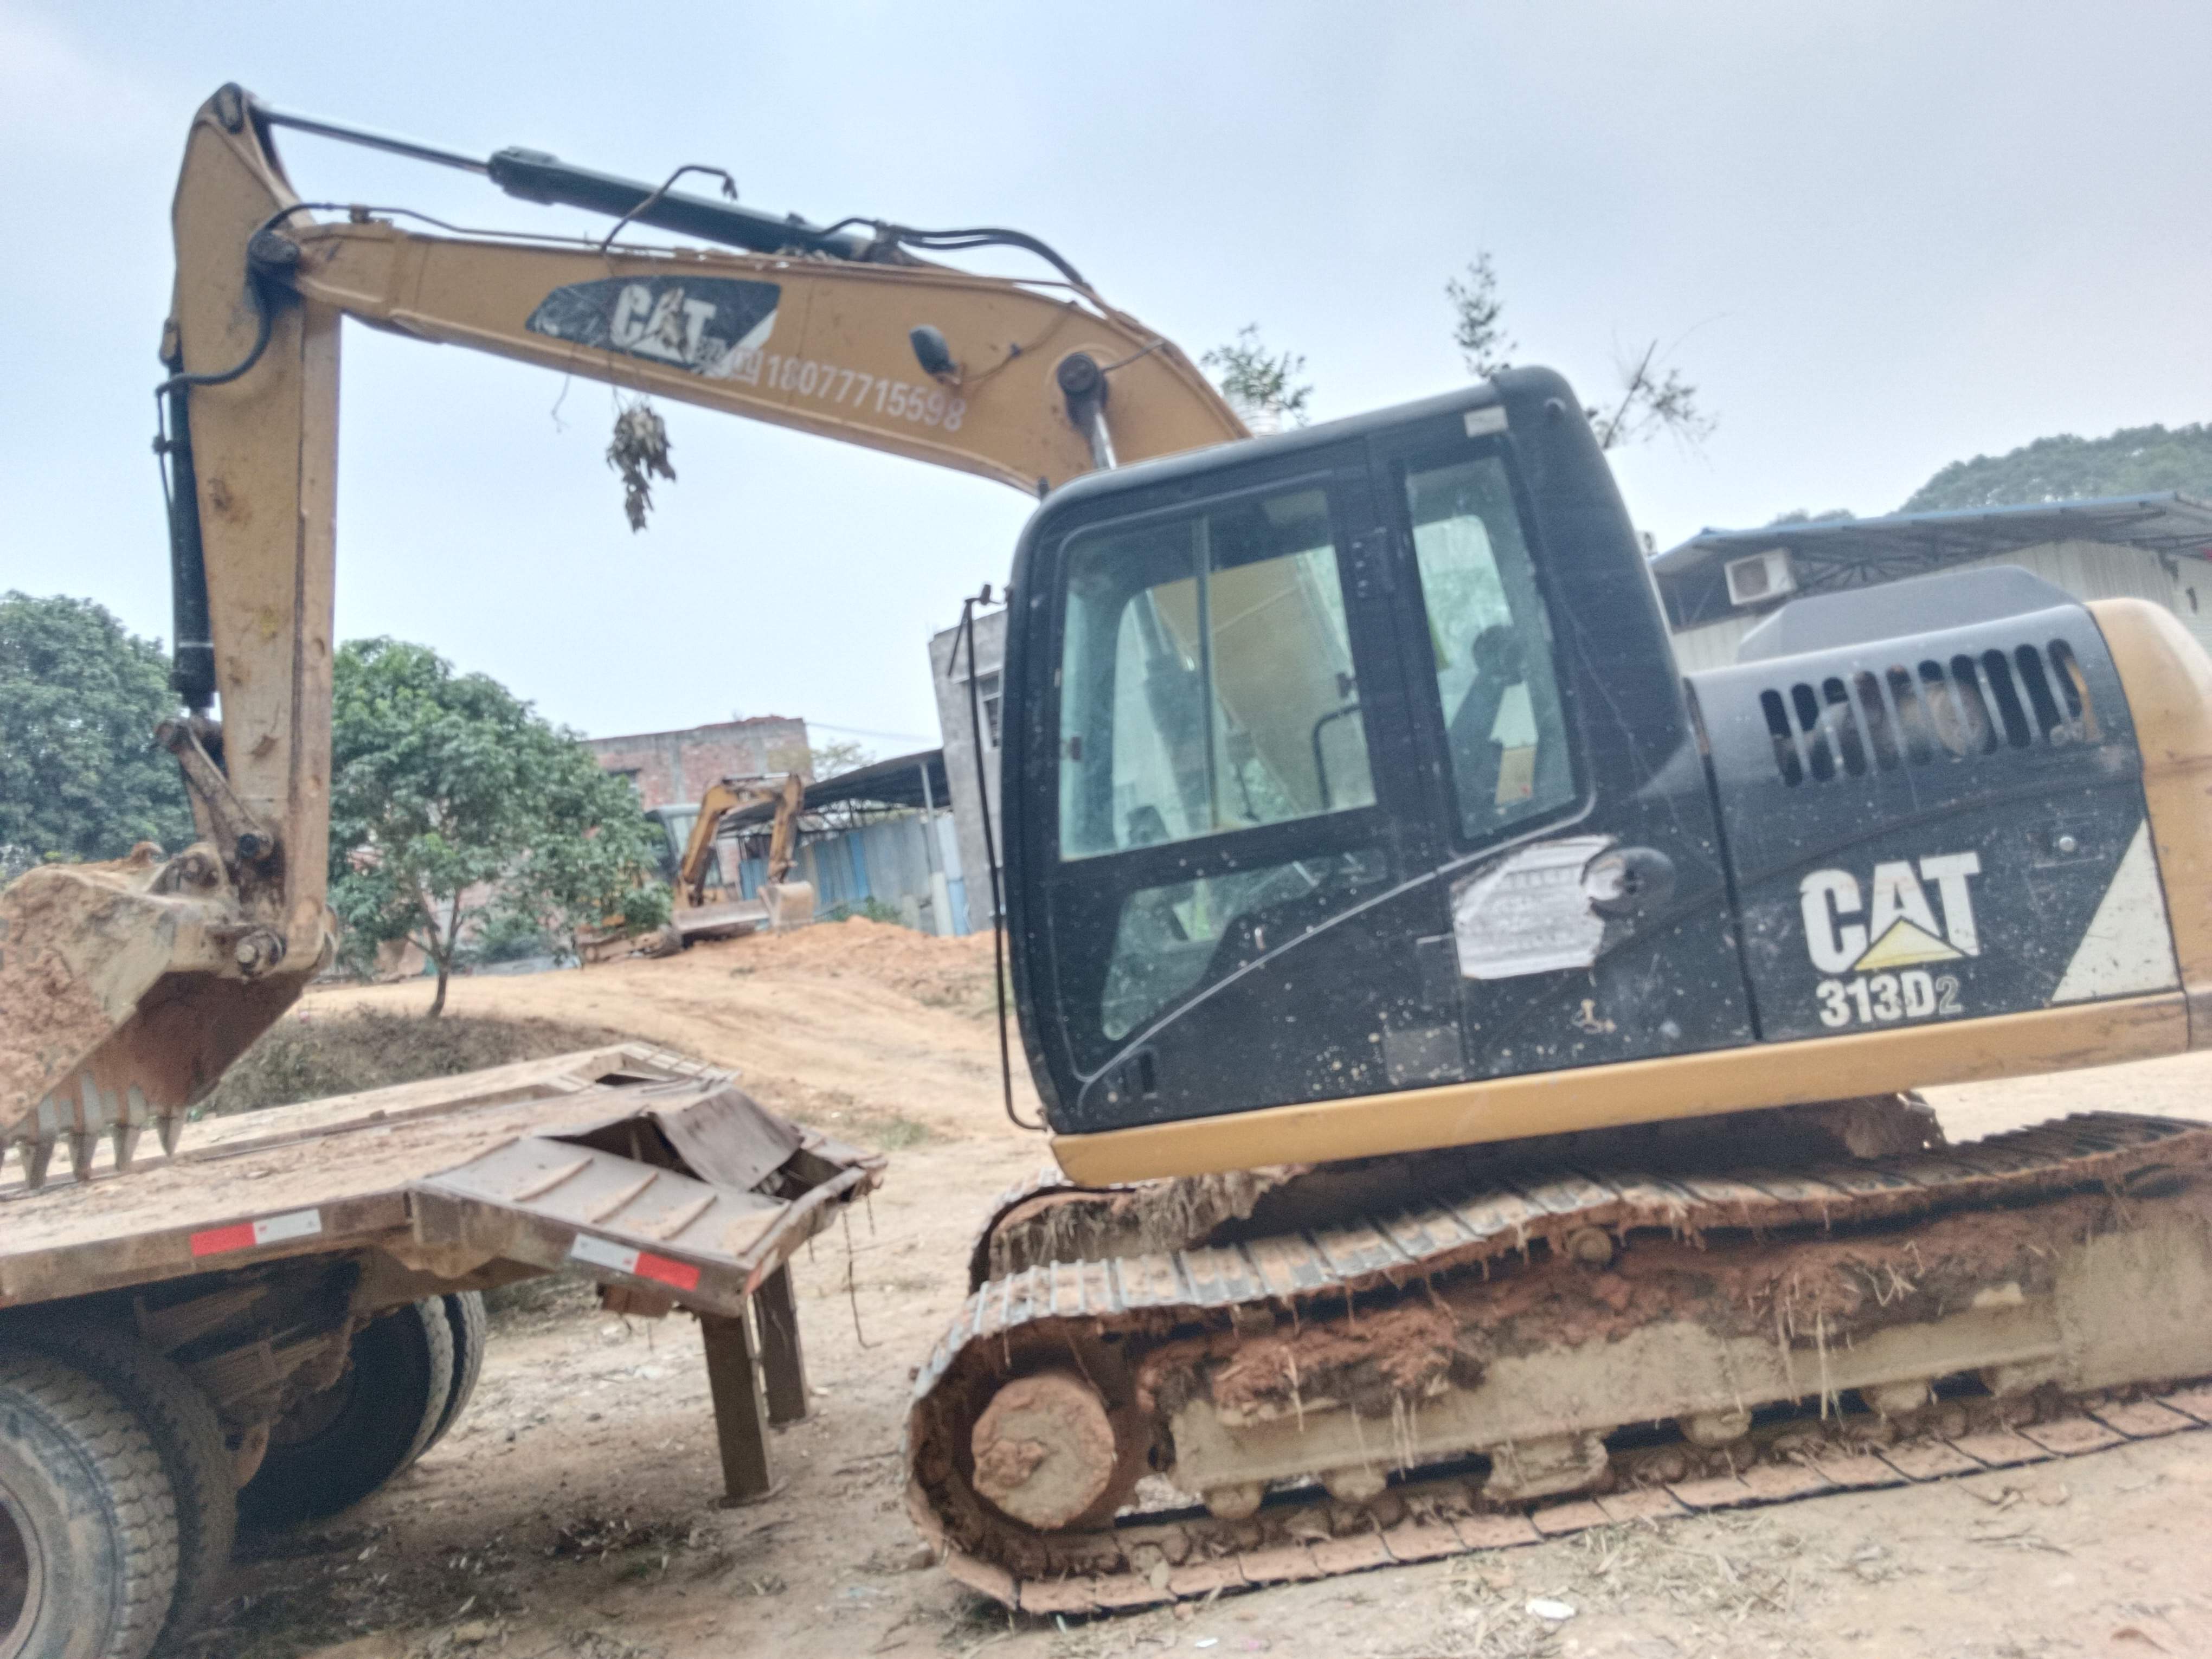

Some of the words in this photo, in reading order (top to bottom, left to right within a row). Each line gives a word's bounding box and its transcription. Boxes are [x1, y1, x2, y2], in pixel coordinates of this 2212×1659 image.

[610, 284, 717, 364] CAT
[1799, 851, 1982, 974] CAT
[1816, 969, 1962, 1027] 313D2
